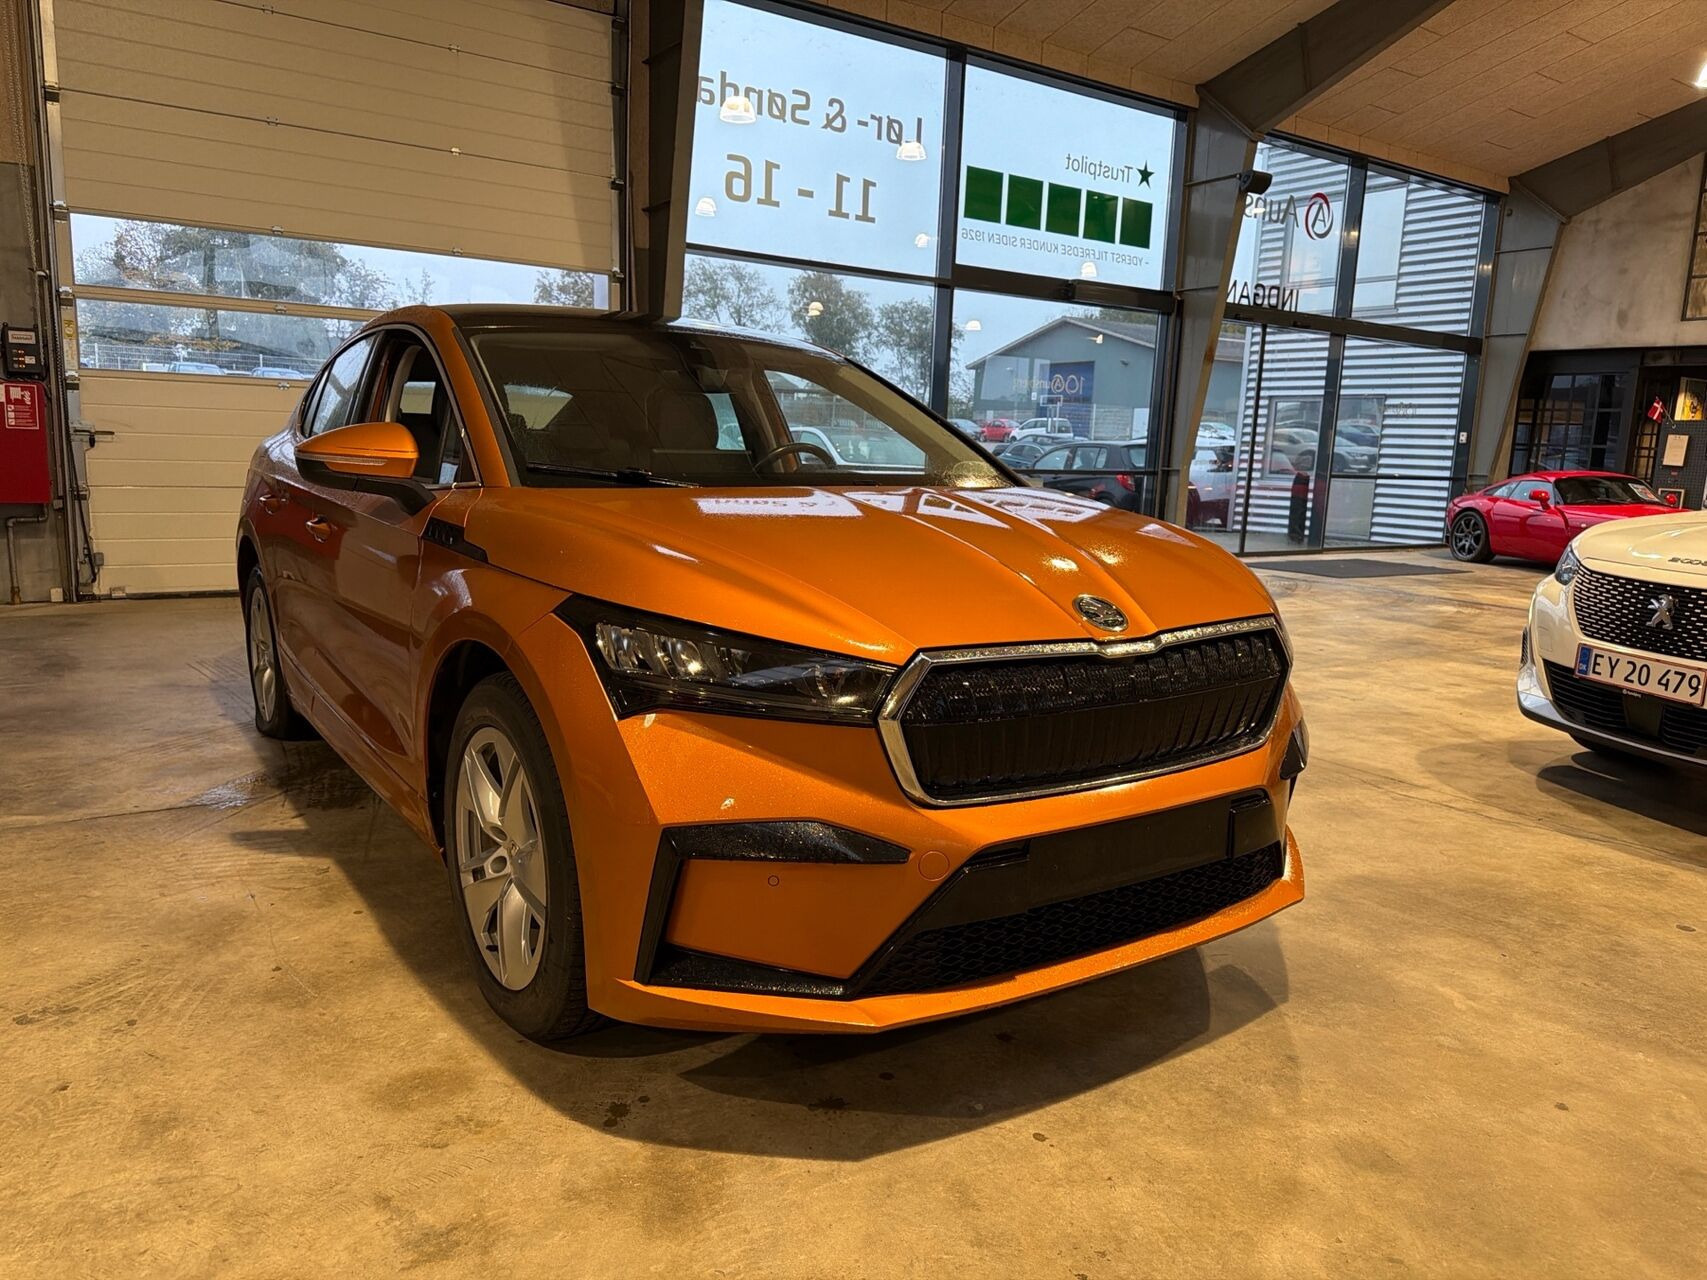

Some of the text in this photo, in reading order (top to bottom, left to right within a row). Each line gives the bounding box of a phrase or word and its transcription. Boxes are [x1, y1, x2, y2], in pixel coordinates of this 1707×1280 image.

[1592, 653, 1701, 697] EY 20 479
